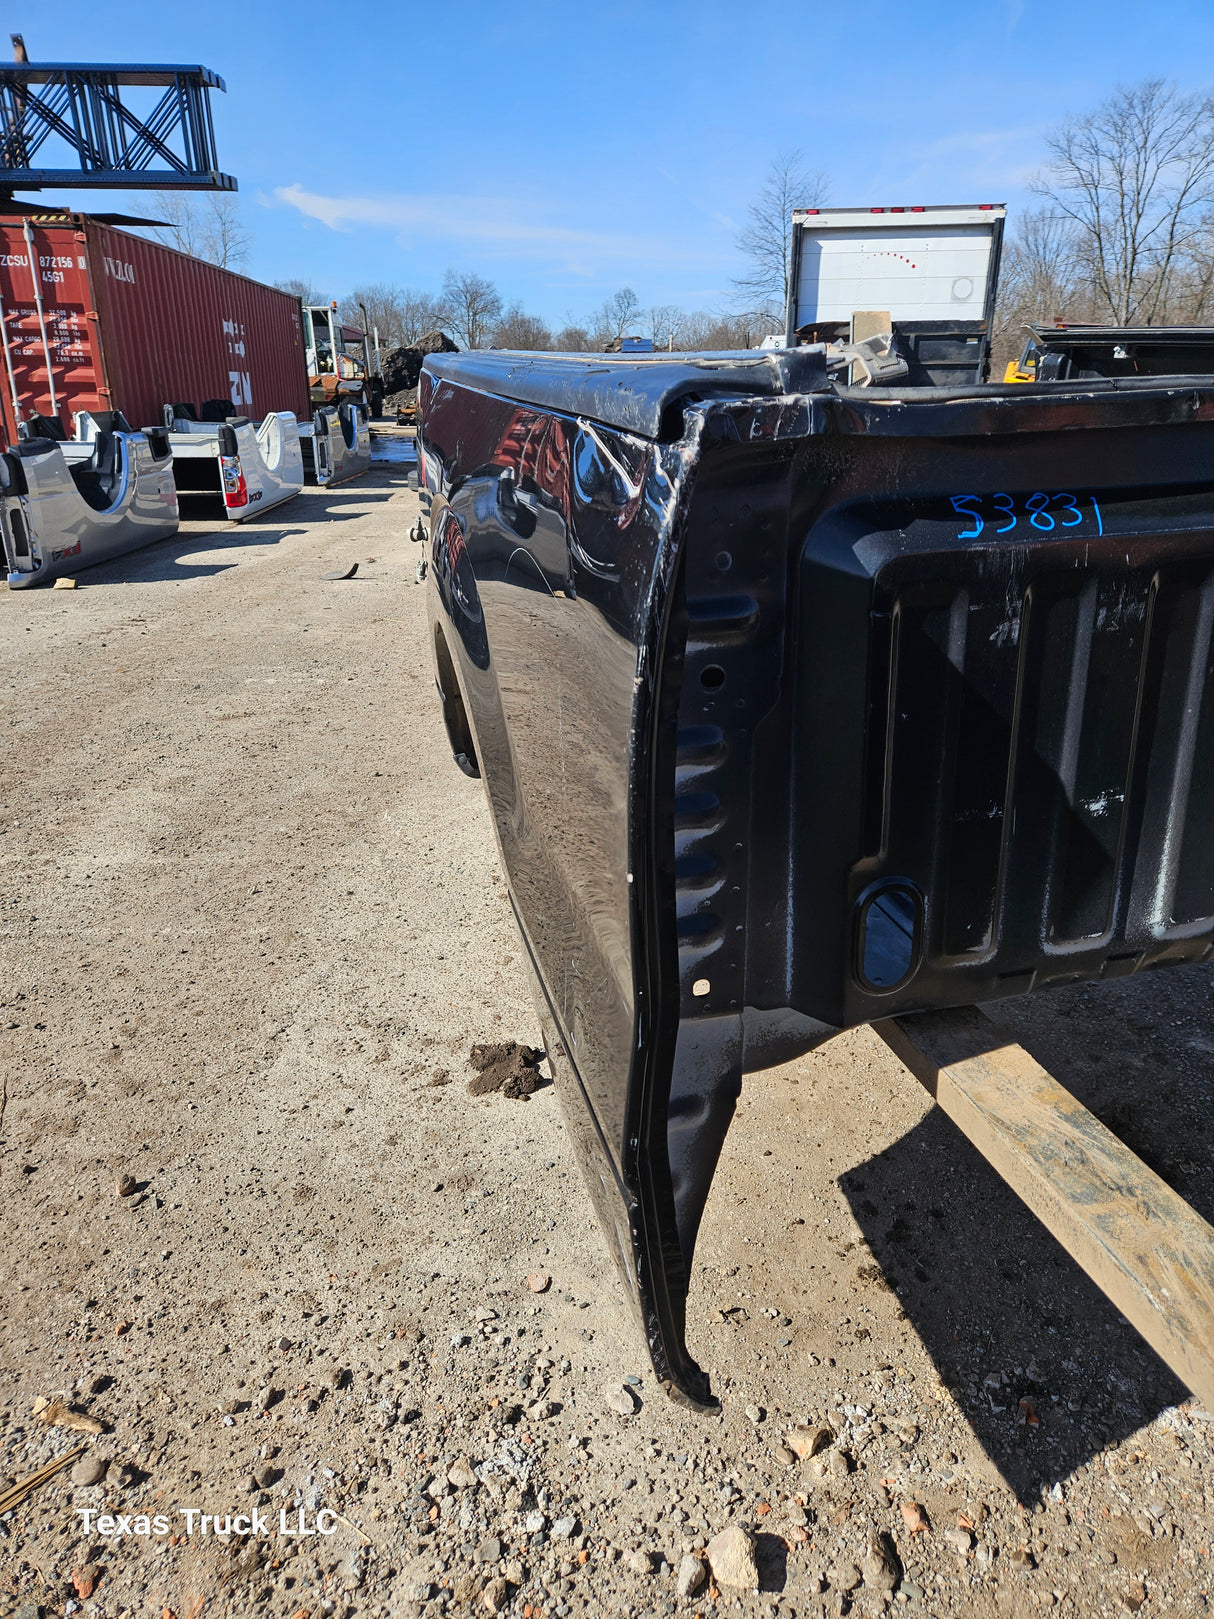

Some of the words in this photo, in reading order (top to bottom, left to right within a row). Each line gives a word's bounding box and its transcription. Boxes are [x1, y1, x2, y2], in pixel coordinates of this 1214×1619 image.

[0, 255, 28, 267] ZCSU
[40, 256, 73, 269] 872156
[42, 271, 64, 283] 45G1
[950, 492, 1102, 539] 53831
